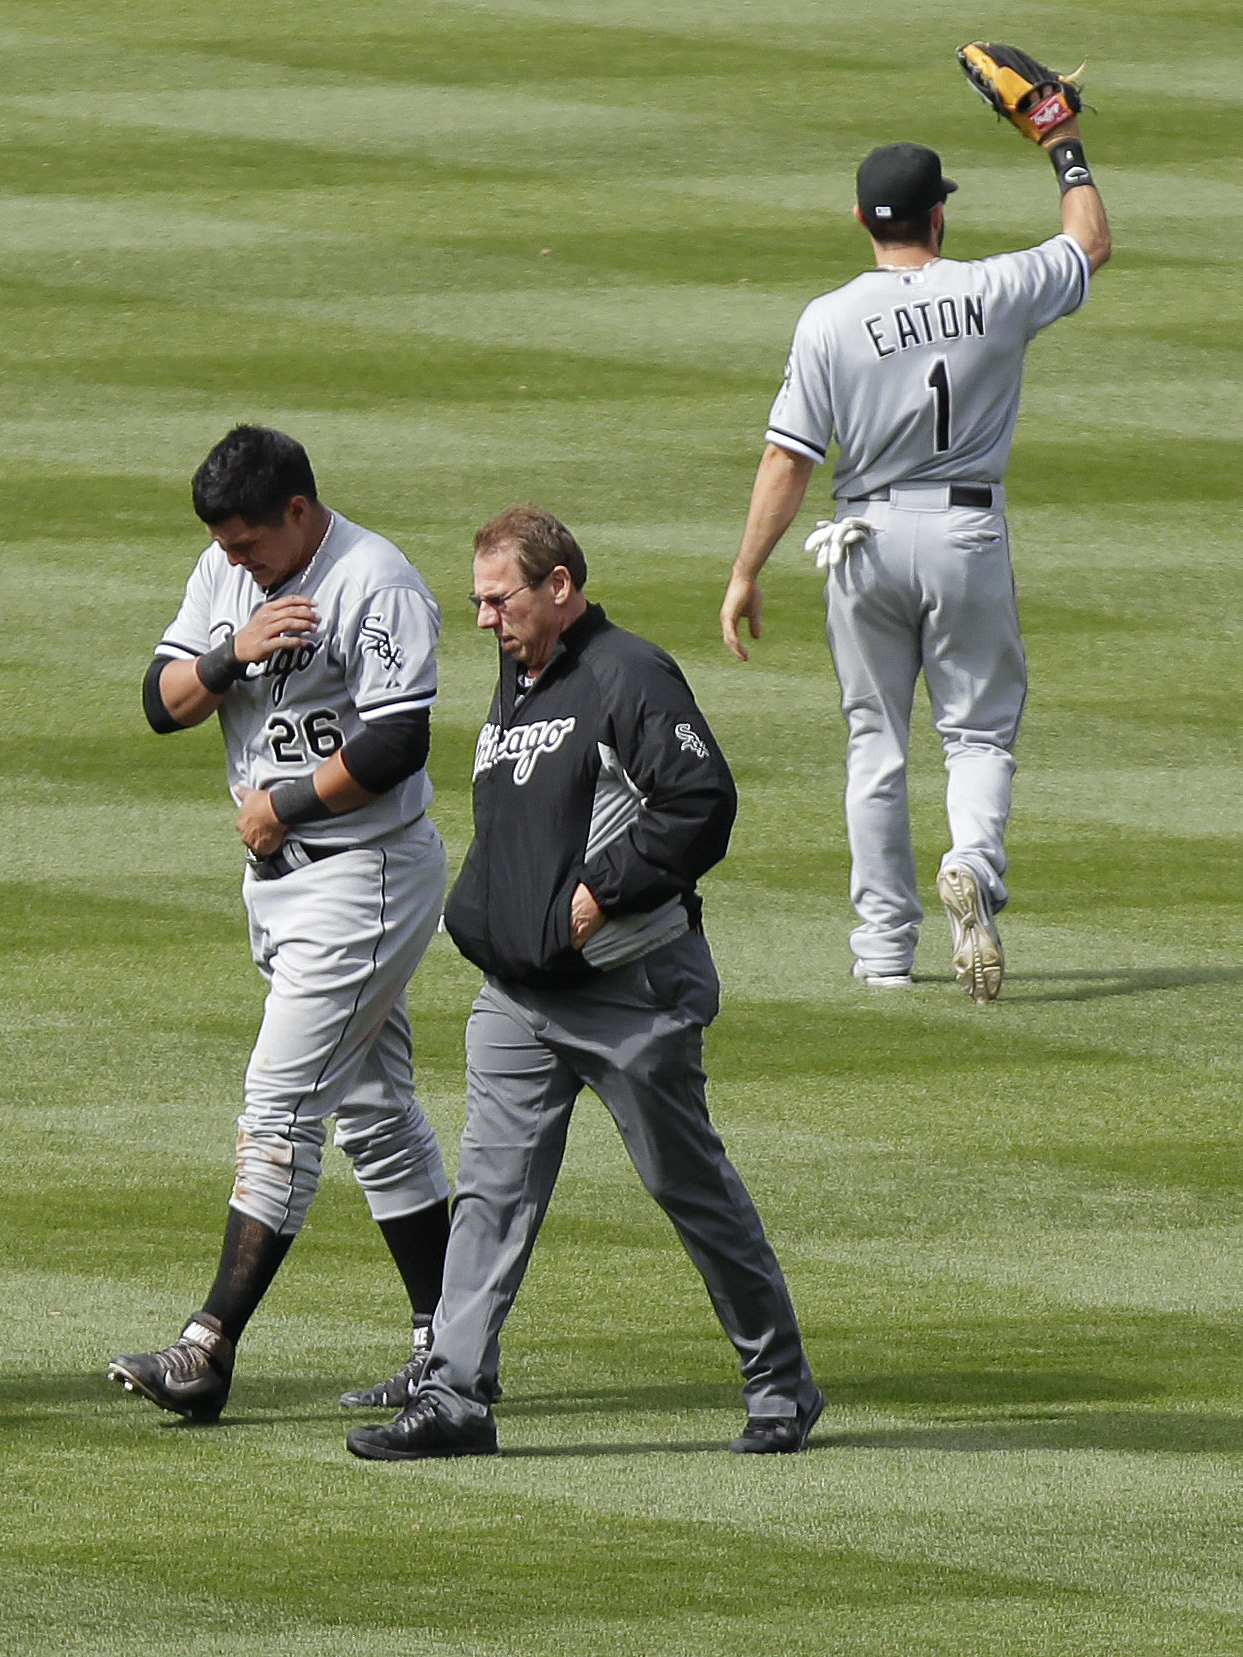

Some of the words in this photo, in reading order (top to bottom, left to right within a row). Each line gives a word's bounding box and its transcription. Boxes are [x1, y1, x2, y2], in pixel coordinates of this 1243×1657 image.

[863, 292, 986, 360] EATON
[924, 354, 953, 455] 1
[360, 612, 405, 671] Sox
[265, 707, 347, 764] 26
[675, 722, 710, 759] Sox
